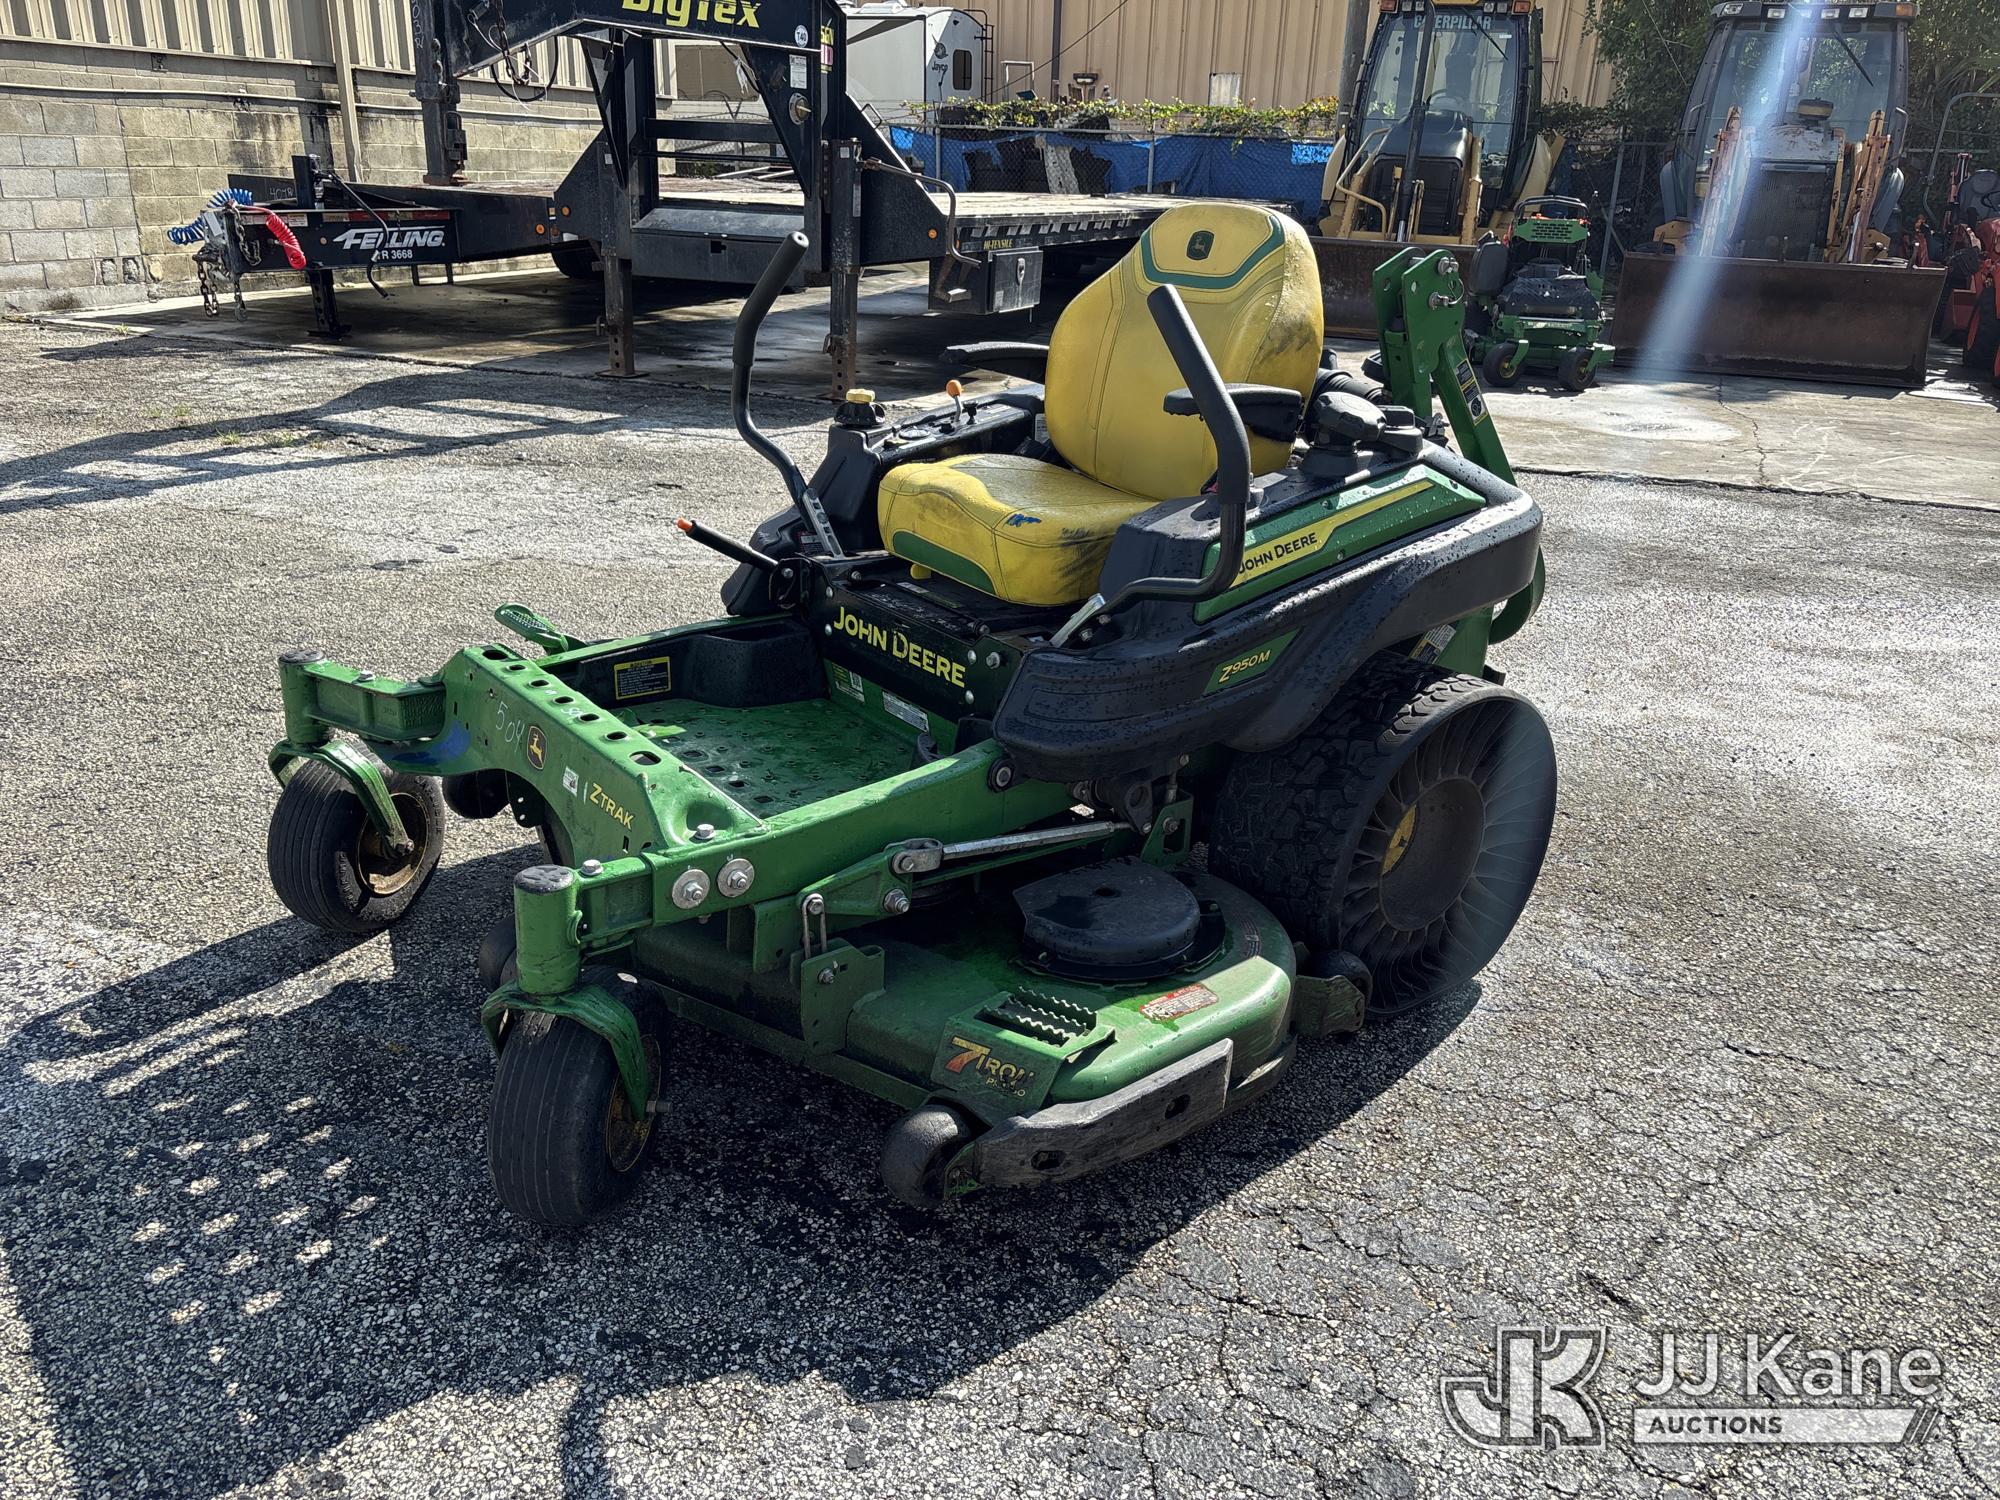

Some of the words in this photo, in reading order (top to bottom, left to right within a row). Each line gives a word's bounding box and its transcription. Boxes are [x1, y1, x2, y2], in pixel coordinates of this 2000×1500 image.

[1413, 14, 1492, 30] CERPILAR
[391, 250, 413, 259] 3668
[1238, 550, 1273, 574] JOHN
[1274, 532, 1318, 559] DEERE
[834, 606, 887, 651] JOHN
[892, 630, 966, 688] DEERE
[1218, 649, 1271, 683] Z950M
[590, 782, 635, 831] ZTRAK
